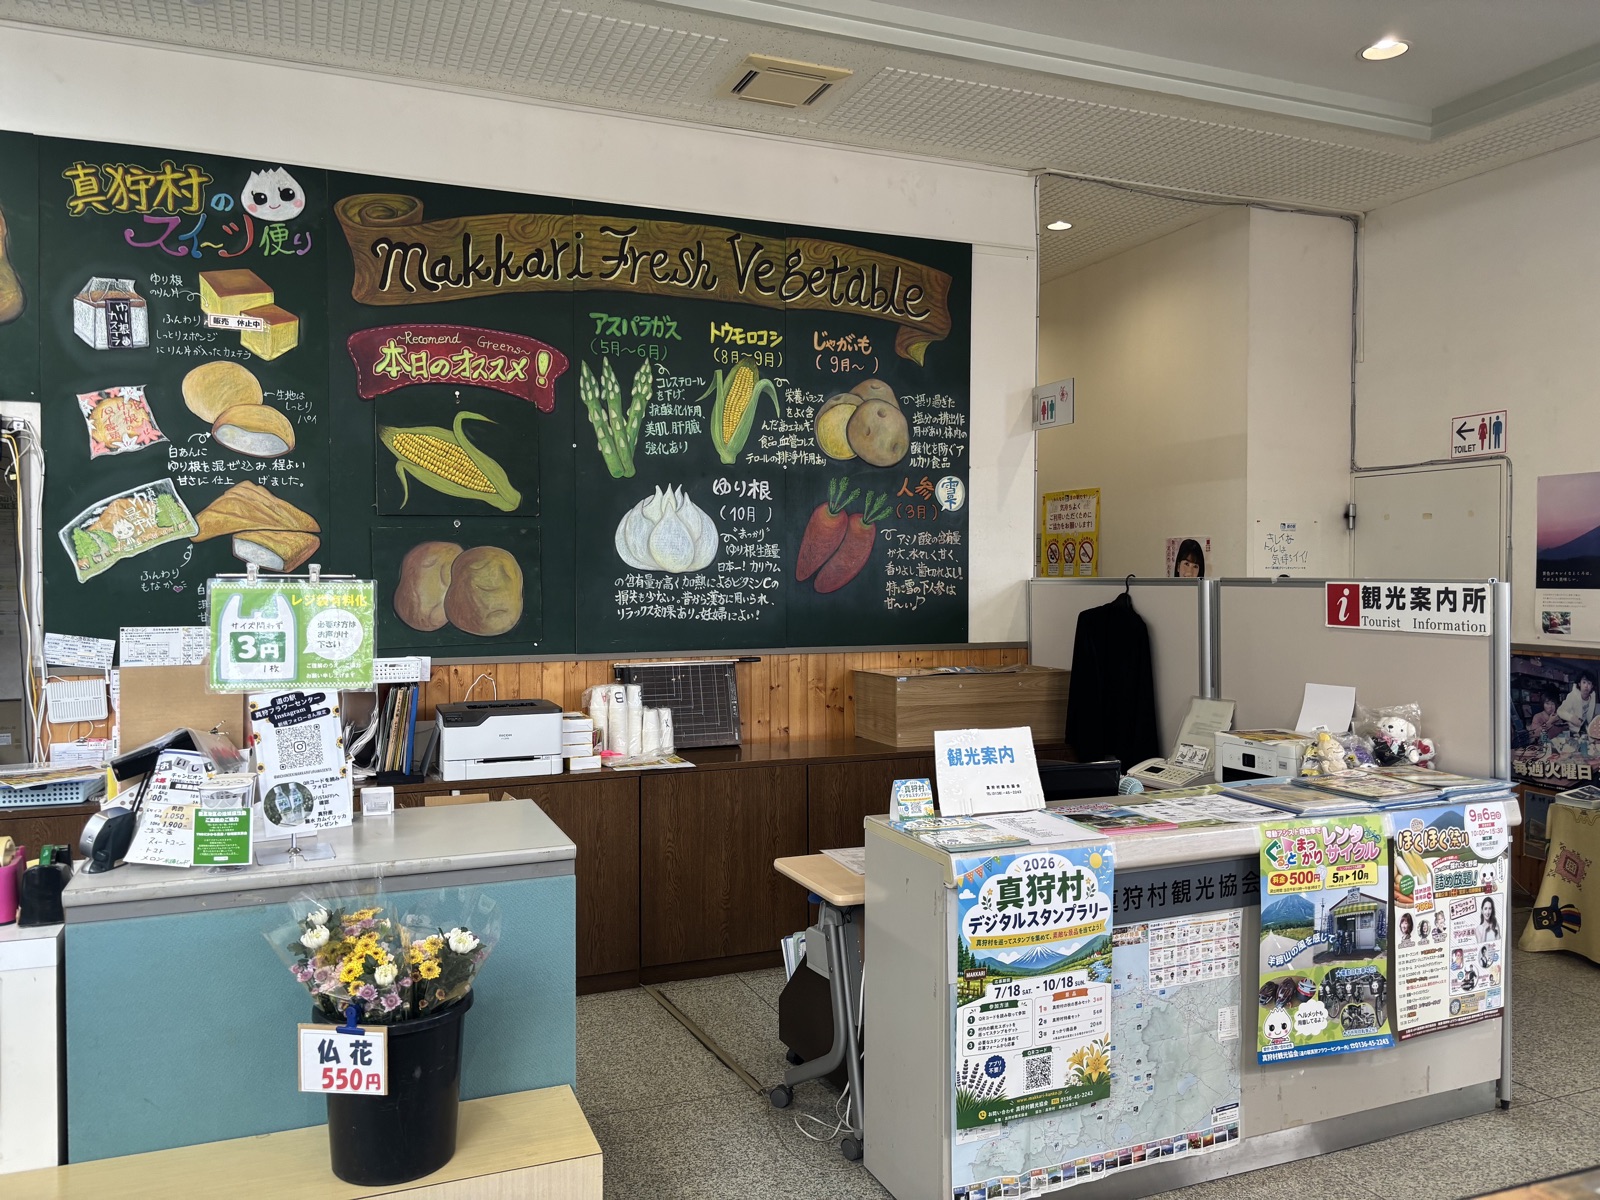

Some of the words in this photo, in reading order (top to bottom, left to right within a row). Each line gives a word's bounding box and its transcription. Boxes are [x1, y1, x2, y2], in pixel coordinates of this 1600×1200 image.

[62, 160, 234, 217] 真狩村の
[150, 273, 183, 286] ゆり根
[372, 231, 592, 292] Makkari
[600, 226, 718, 291] Fresh
[728, 233, 930, 320] Vegetable
[162, 314, 201, 325] ふんわり
[237, 319, 261, 328] 休止中
[589, 312, 682, 341] アスパラガス
[108, 311, 119, 345] カステラ
[710, 321, 783, 347] トウモロコシ
[813, 330, 873, 354] じゃがいも
[656, 376, 706, 389] コレステロール
[276, 389, 305, 401] 生地は
[785, 388, 825, 404] 栄養バランス
[914, 393, 956, 408] 摂り過ぎた
[298, 415, 317, 424] パイ
[786, 406, 815, 418] をよく含
[912, 411, 966, 426] 塩分の排出作
[169, 444, 208, 458] 白あんに
[645, 441, 689, 455] 強化あり
[911, 441, 965, 457] 酸化を防ぐア
[1454, 444, 1476, 454] TOILET
[909, 455, 951, 469] ルカリ食品
[712, 477, 773, 501] ゆり根
[896, 475, 934, 501] 人参
[897, 530, 962, 546] アミノ酸の含有量
[1266, 532, 1295, 544] キレイな
[725, 543, 781, 558] ゆり根生産量
[141, 569, 180, 581] ふんわり
[141, 580, 173, 592] もなか
[885, 579, 957, 596] 特に雪の下人参は
[1361, 585, 1487, 614] 観光案内所
[1361, 615, 1401, 628] Tourist
[1413, 618, 1487, 632] Information
[237, 634, 280, 660] 3円
[317, 640, 341, 649] 下さい
[275, 694, 297, 705] 道の駅
[255, 696, 321, 719] 真狩フラワーセンター
[274, 707, 307, 720] Instagram
[947, 745, 1015, 767] 観光案内
[1512, 760, 1593, 780] 毎週火曜日
[903, 784, 925, 792] 真狩村
[1321, 823, 1364, 846] レンタ
[1397, 827, 1470, 853] ほくほく祭り
[1325, 841, 1380, 865] サイクル
[1023, 857, 1055, 871] 2026
[1272, 876, 1286, 884] 料金
[1289, 871, 1321, 885] 500円
[1332, 872, 1344, 883] 5月
[1352, 870, 1369, 880] 10月
[1434, 870, 1479, 890] 詰め放題!
[996, 869, 1085, 913] 真狩村
[969, 903, 1109, 935] デジタルスタンプラリー
[966, 970, 986, 978] MAKKARI
[994, 984, 1021, 999] 7/18
[1042, 976, 1073, 992] 10/18
[988, 1002, 1009, 1010] 参加方法
[1297, 1010, 1324, 1018] ヘルメットも
[1262, 1050, 1299, 1062] 真狩村観光協会
[322, 1067, 381, 1091] 550円
